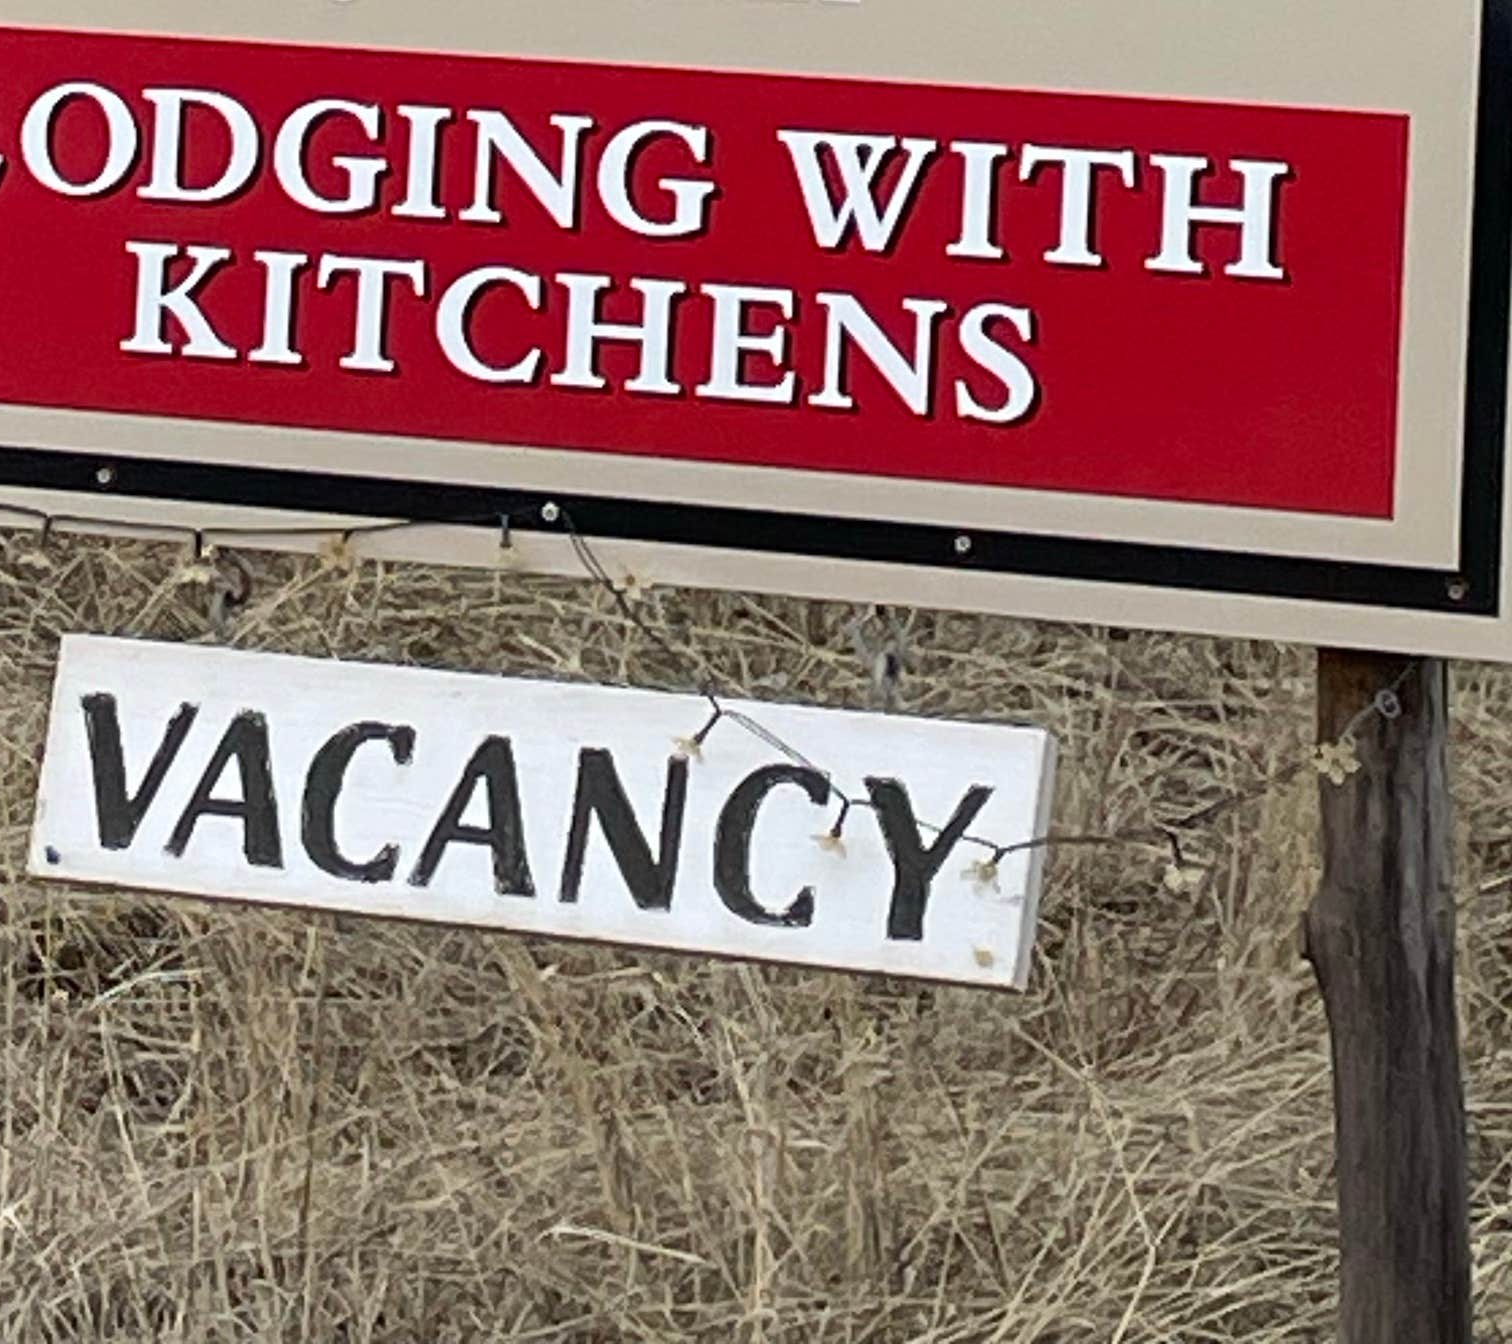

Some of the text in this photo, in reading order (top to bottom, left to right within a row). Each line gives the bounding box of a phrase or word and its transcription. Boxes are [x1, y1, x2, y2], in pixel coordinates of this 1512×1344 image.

[777, 128, 1292, 284] WITH
[120, 239, 1044, 428] KITCHENS
[80, 691, 989, 943] VACANCY
